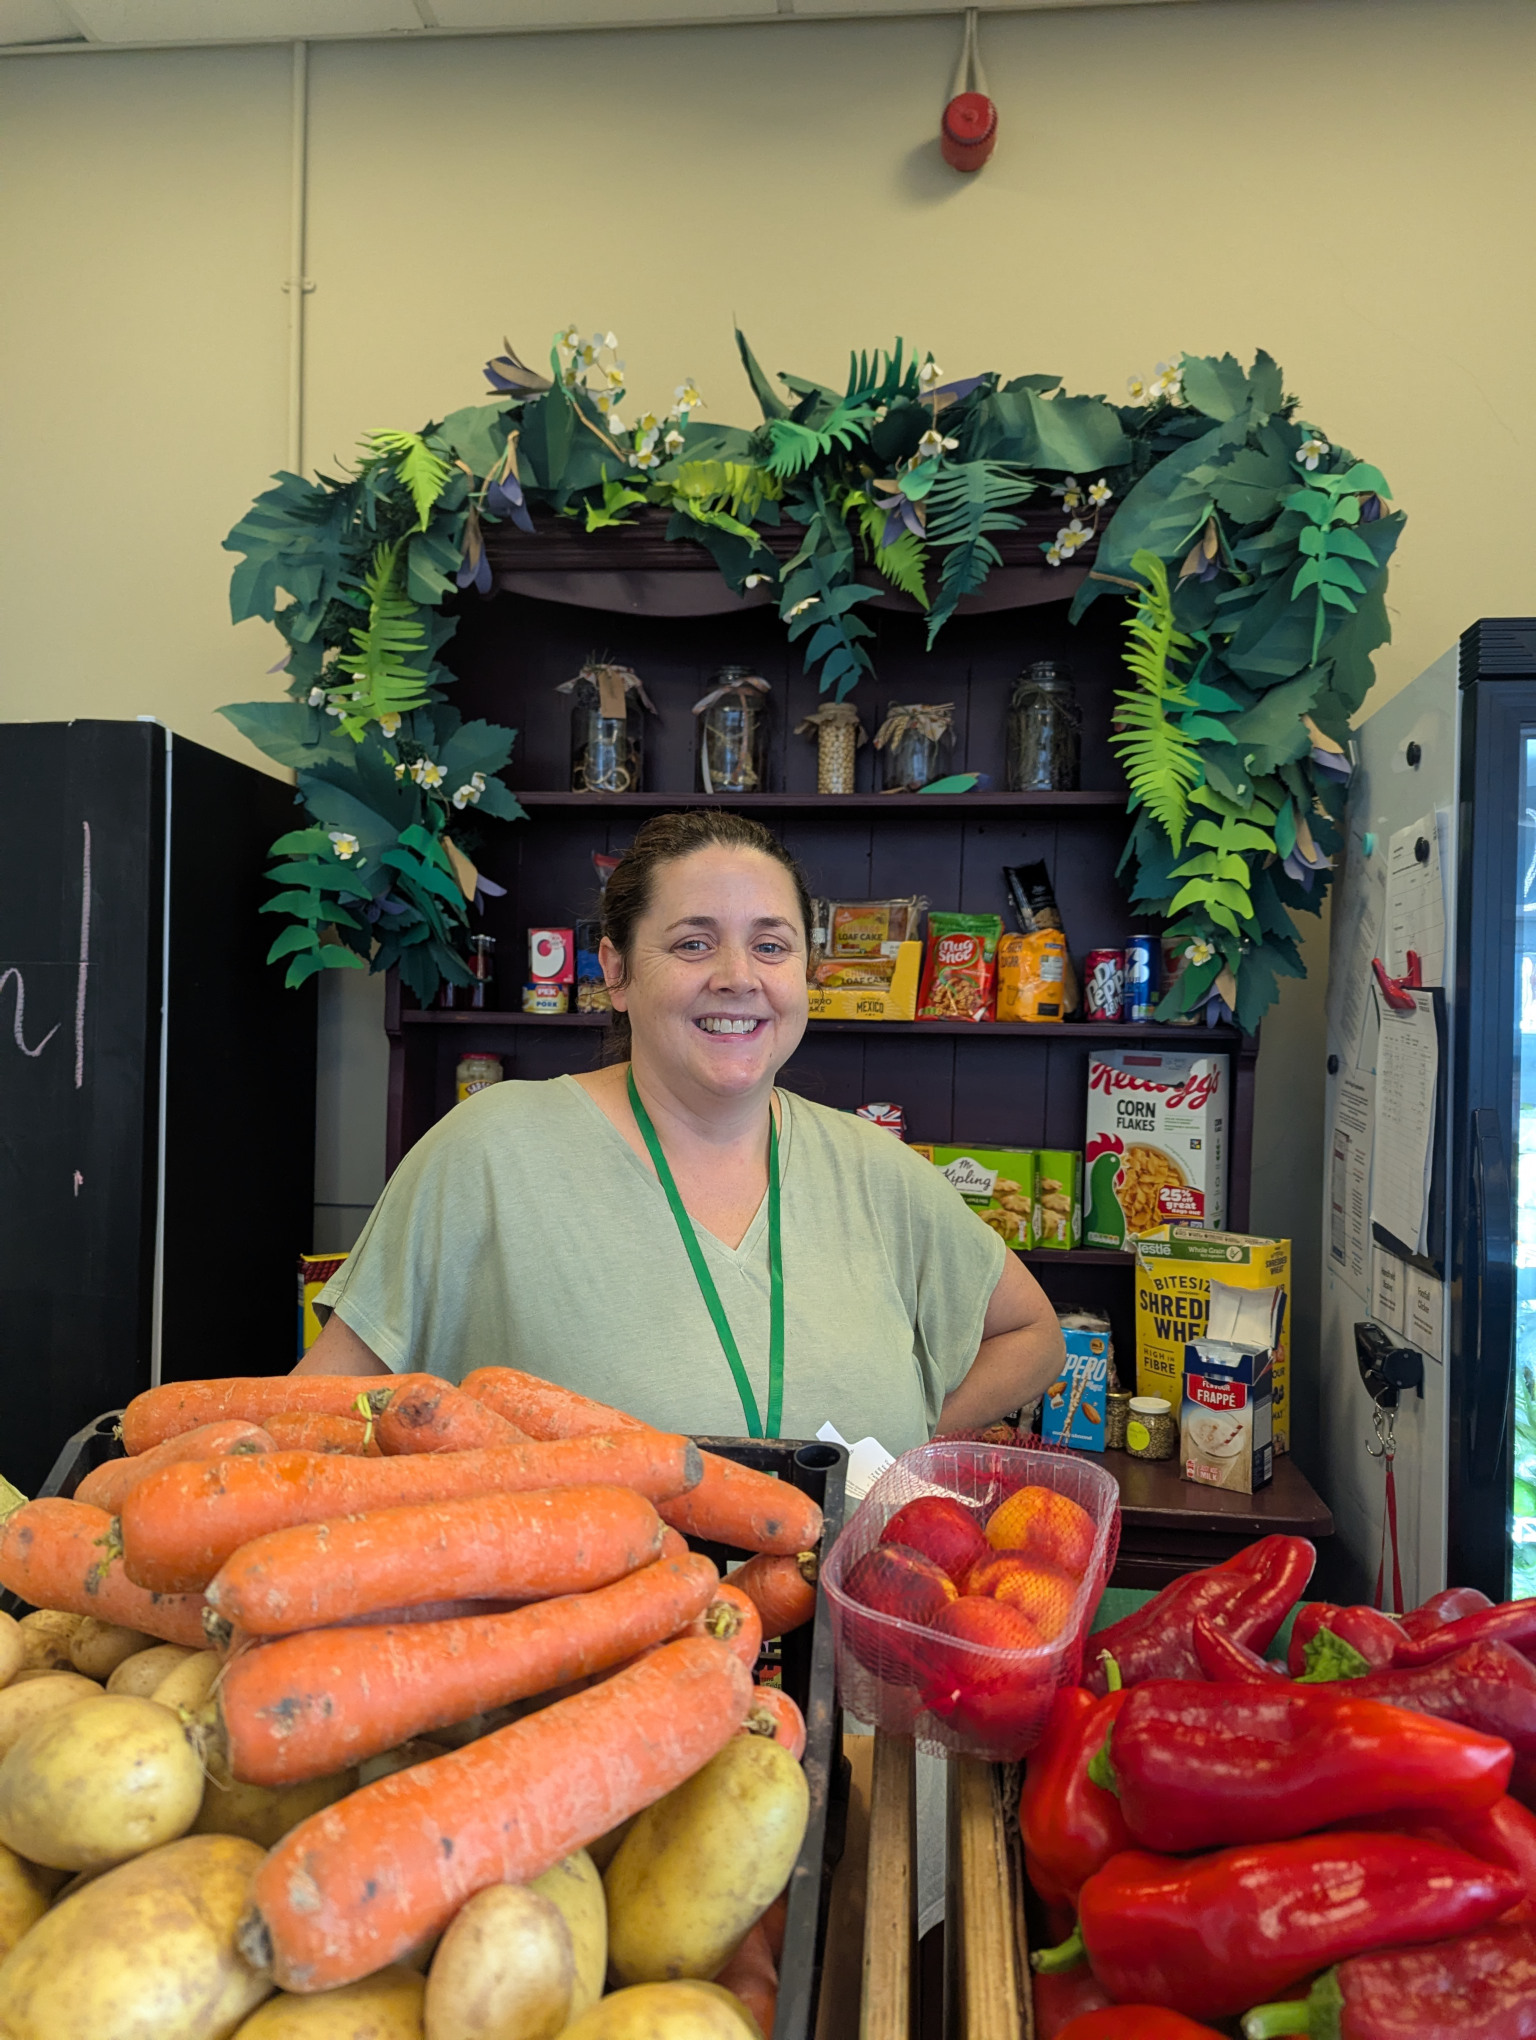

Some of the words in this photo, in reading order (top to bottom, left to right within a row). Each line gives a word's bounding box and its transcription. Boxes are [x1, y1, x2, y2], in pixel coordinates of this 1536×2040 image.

[838, 933, 859, 941] LOAF
[860, 933, 883, 941] CAKE
[841, 977, 865, 985] LOAF
[1093, 958, 1116, 988] Dr
[1086, 969, 1124, 1014] Pepp
[536, 1000, 558, 1008] PORK
[808, 998, 832, 1006] URRO
[856, 1001, 884, 1014] MEXICO
[1117, 1099, 1157, 1119] CORN
[1116, 1117, 1156, 1133] FLAKES
[958, 1159, 974, 1170] Mr
[942, 1168, 991, 1191] Kipling
[1159, 1187, 1192, 1203] 25%
[1165, 1202, 1197, 1210] great
[1188, 1246, 1208, 1254] Whole
[1208, 1247, 1226, 1255] Grain
[1153, 1275, 1211, 1293] BITESIZ
[1140, 1289, 1211, 1322] SHRED
[1153, 1316, 1208, 1343] WHE
[1143, 1347, 1165, 1359] HIGH
[1060, 1353, 1108, 1382] PERO
[1143, 1356, 1176, 1375] FIBRE
[1197, 1388, 1237, 1408] FRAPPÉ
[1199, 1471, 1217, 1481] MILK
